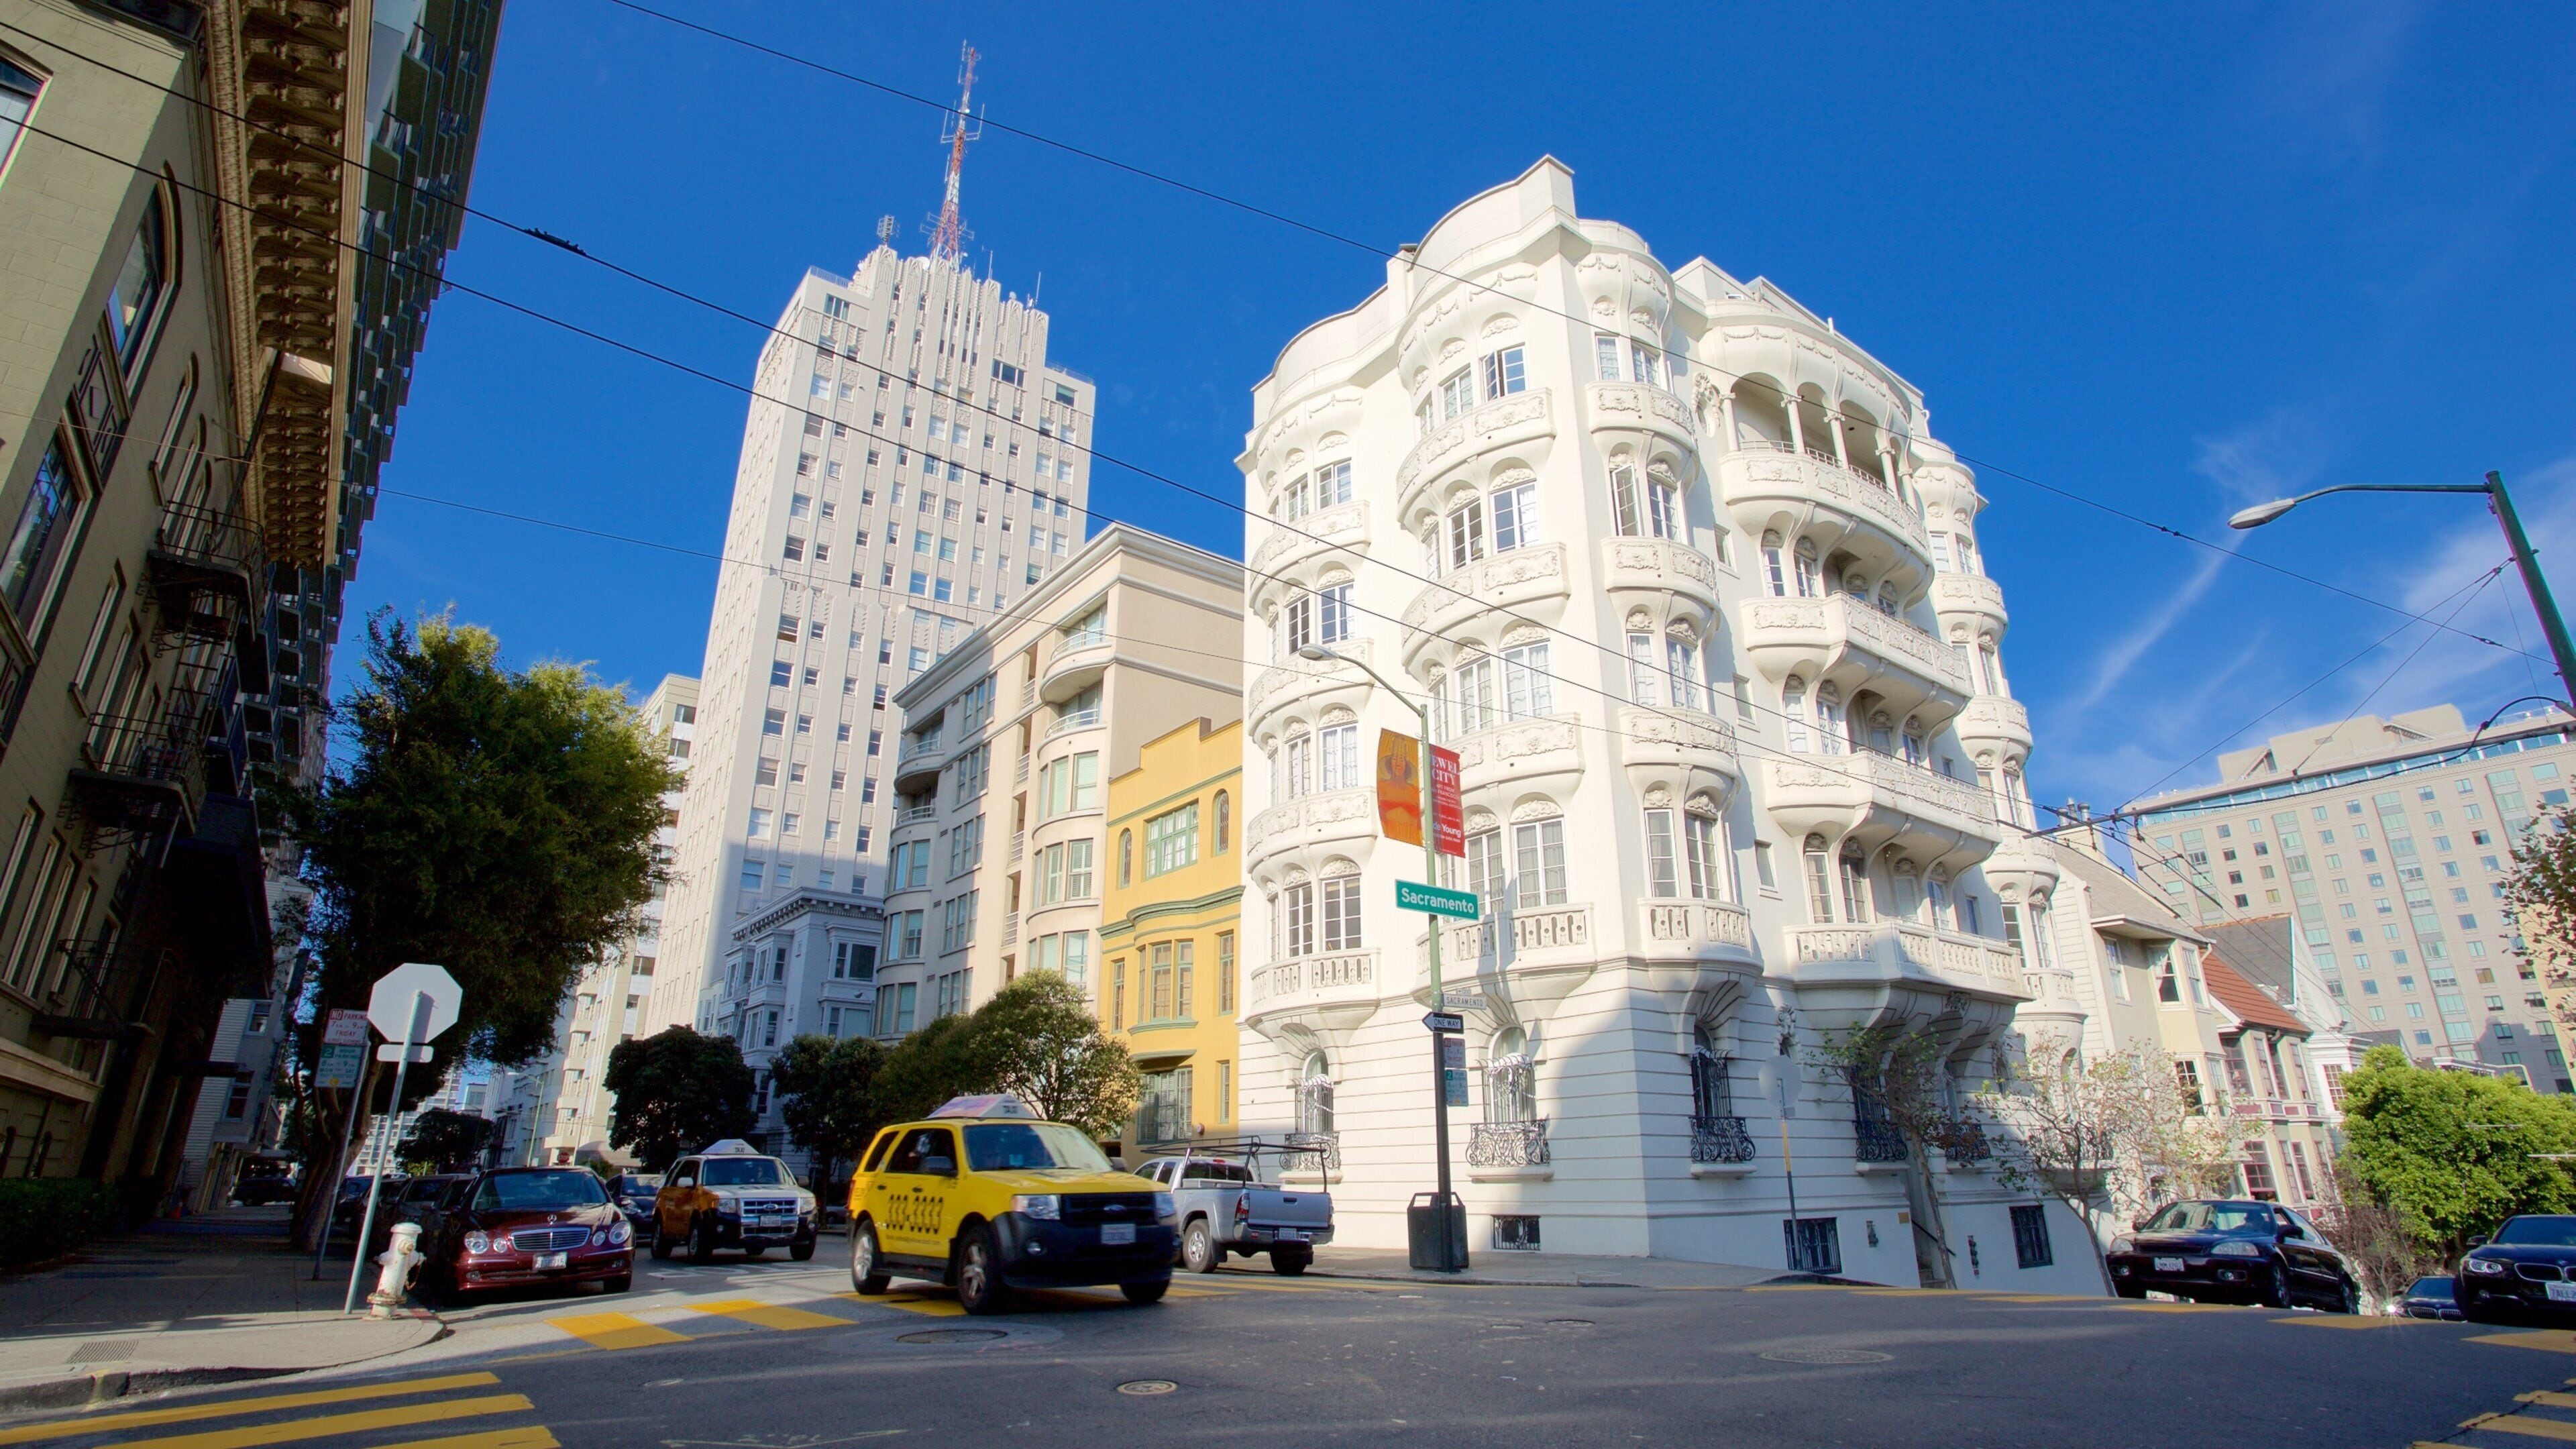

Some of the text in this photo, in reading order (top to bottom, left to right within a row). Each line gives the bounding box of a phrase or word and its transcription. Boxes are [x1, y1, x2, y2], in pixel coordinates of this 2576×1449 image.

[1430, 754, 1460, 775] EWEL
[1432, 768, 1455, 786] CITY
[1433, 821, 1461, 839] de Young
[1401, 888, 1474, 914] Sacramento
[1446, 996, 1484, 1007] SACRAMENTO
[331, 1010, 368, 1020] NO PARKING
[1434, 1018, 1458, 1028] ONE WAY
[324, 1048, 333, 1057] 2
[1447, 1071, 1452, 1080] 2
